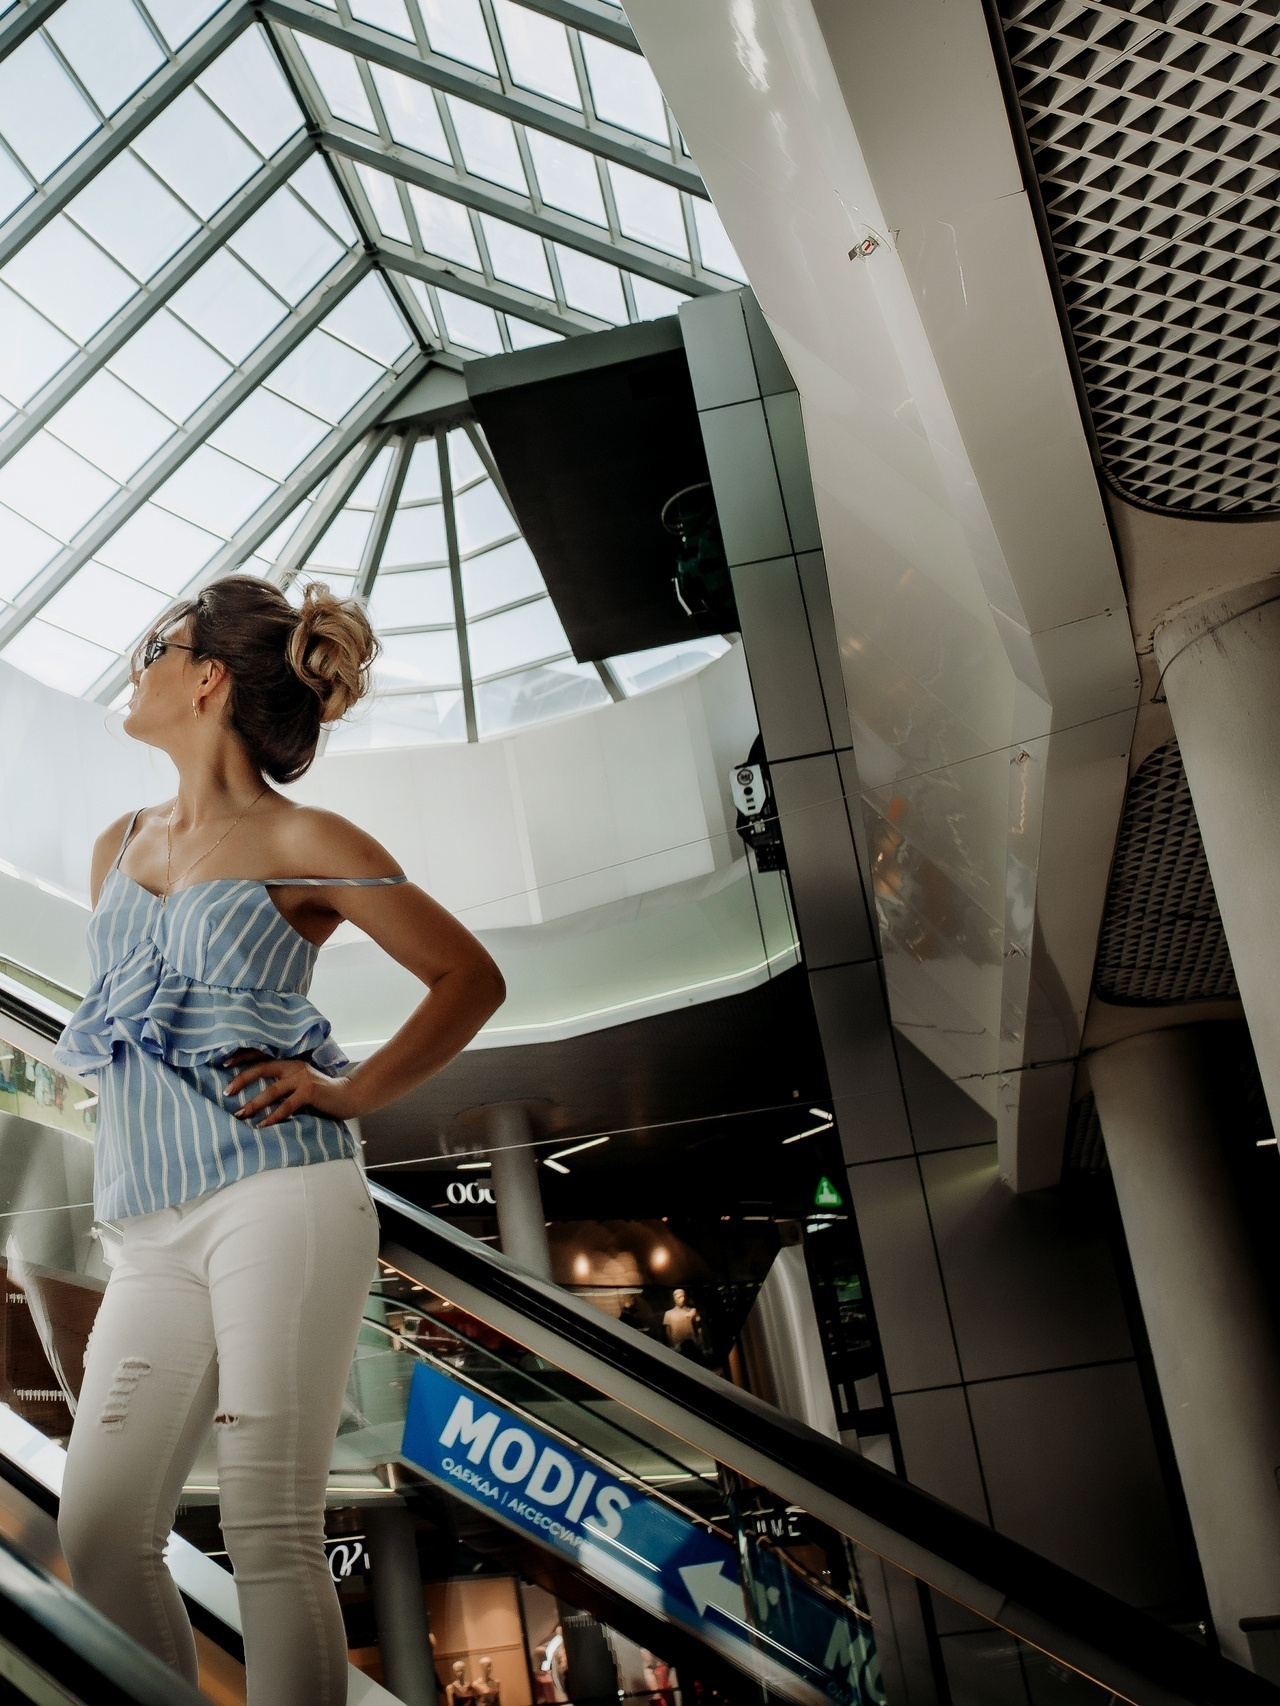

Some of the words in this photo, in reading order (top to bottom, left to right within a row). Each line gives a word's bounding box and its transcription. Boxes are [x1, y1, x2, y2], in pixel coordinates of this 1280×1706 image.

[438, 1395, 632, 1541] MODIS
[441, 1457, 499, 1500] ОДЕЖДА
[507, 1498, 586, 1549] АКСЕССУАР
